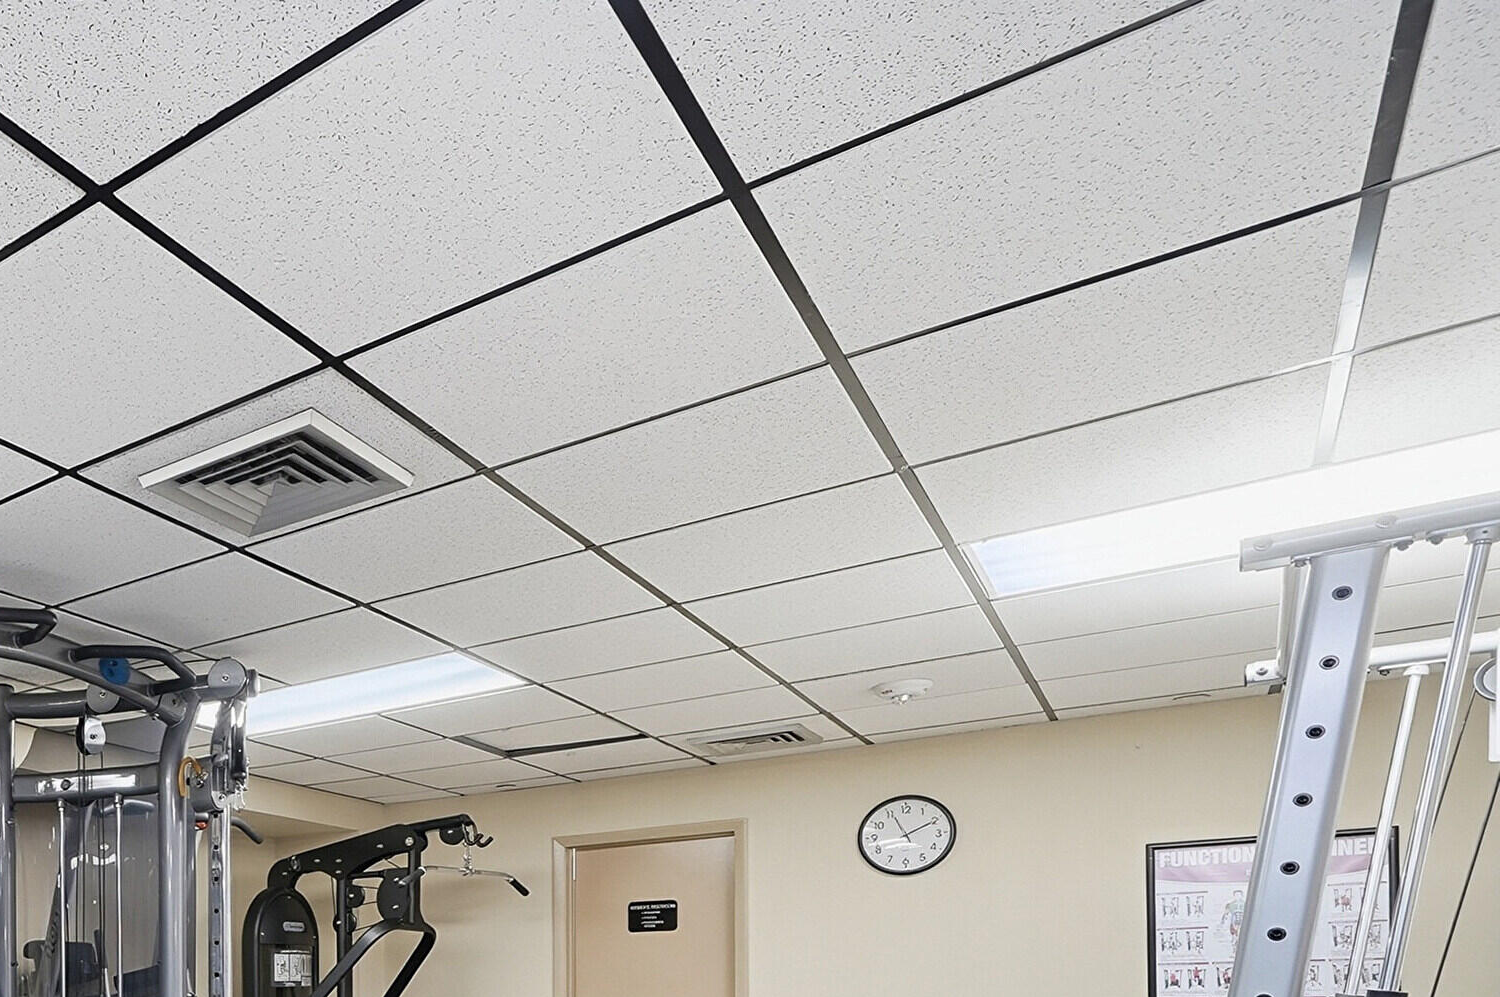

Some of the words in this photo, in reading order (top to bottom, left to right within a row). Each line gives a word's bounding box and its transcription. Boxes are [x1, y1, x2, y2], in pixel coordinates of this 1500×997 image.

[901, 805, 911, 814] 12
[886, 810, 894, 819] 11
[931, 816, 939, 825] 2
[874, 821, 885, 830] 10
[935, 829, 942, 838] 3
[870, 834, 878, 843] 9
[875, 845, 882, 854] 8
[930, 842, 937, 850] 4
[887, 855, 893, 863] 7
[920, 853, 926, 862] 5
[1159, 846, 1256, 868] FUNCTION
